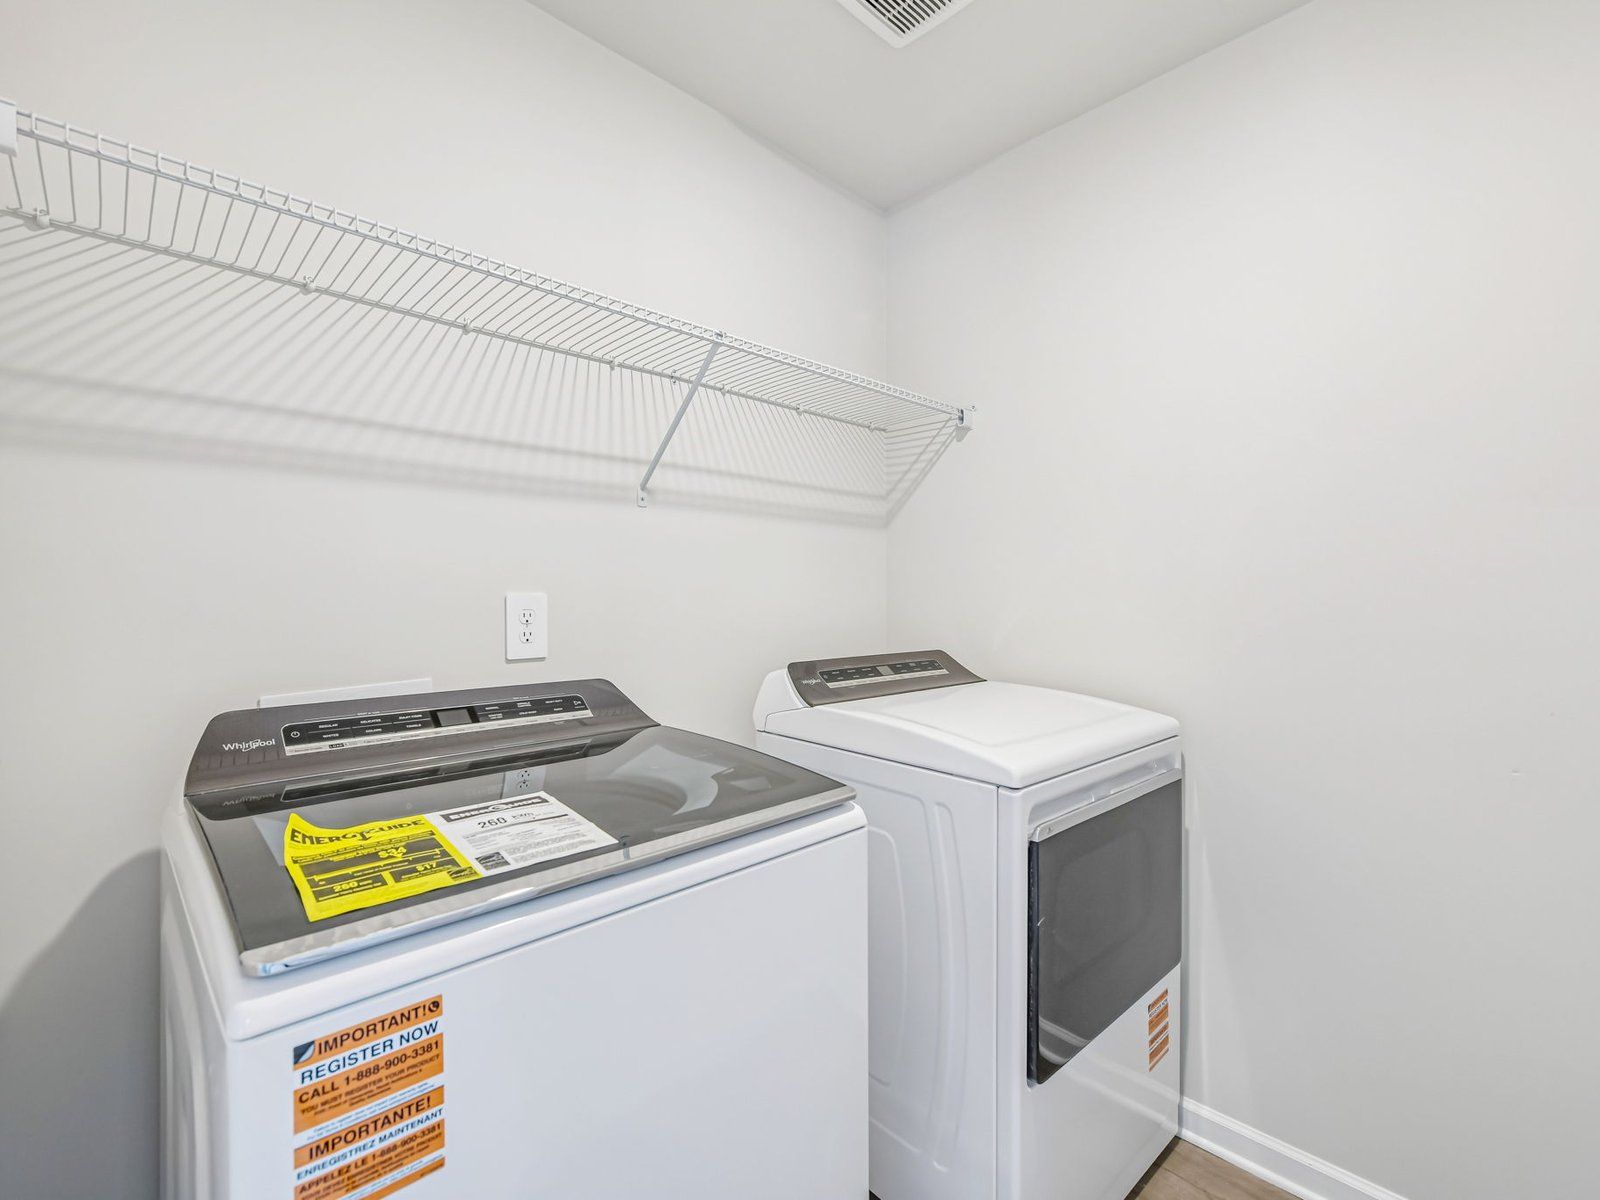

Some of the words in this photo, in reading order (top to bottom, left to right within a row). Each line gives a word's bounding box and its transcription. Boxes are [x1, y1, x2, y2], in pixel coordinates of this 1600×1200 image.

[222, 738, 276, 752] Whirlpool
[477, 816, 507, 829] 260
[300, 1038, 394, 1085] REGISTER
[399, 1021, 439, 1047] NOW
[317, 1004, 427, 1056] IMPORTANT!
[298, 1081, 340, 1104] CALL
[344, 1040, 440, 1086] 1-888-900-3381
[300, 1104, 319, 1115] YOU
[320, 1094, 343, 1106] MUST
[345, 1078, 383, 1097] REGISTER
[385, 1068, 405, 1081] YOUR
[406, 1053, 440, 1072] PRODUCT
[296, 1140, 376, 1181] ENREGISTREZ
[378, 1107, 444, 1144] MAINTENANT
[299, 1166, 352, 1194] APPELEZ
[354, 1157, 368, 1168] LE
[372, 1124, 441, 1162] 1-888-900-3381
[309, 1096, 431, 1160] IMPORTANTE!
